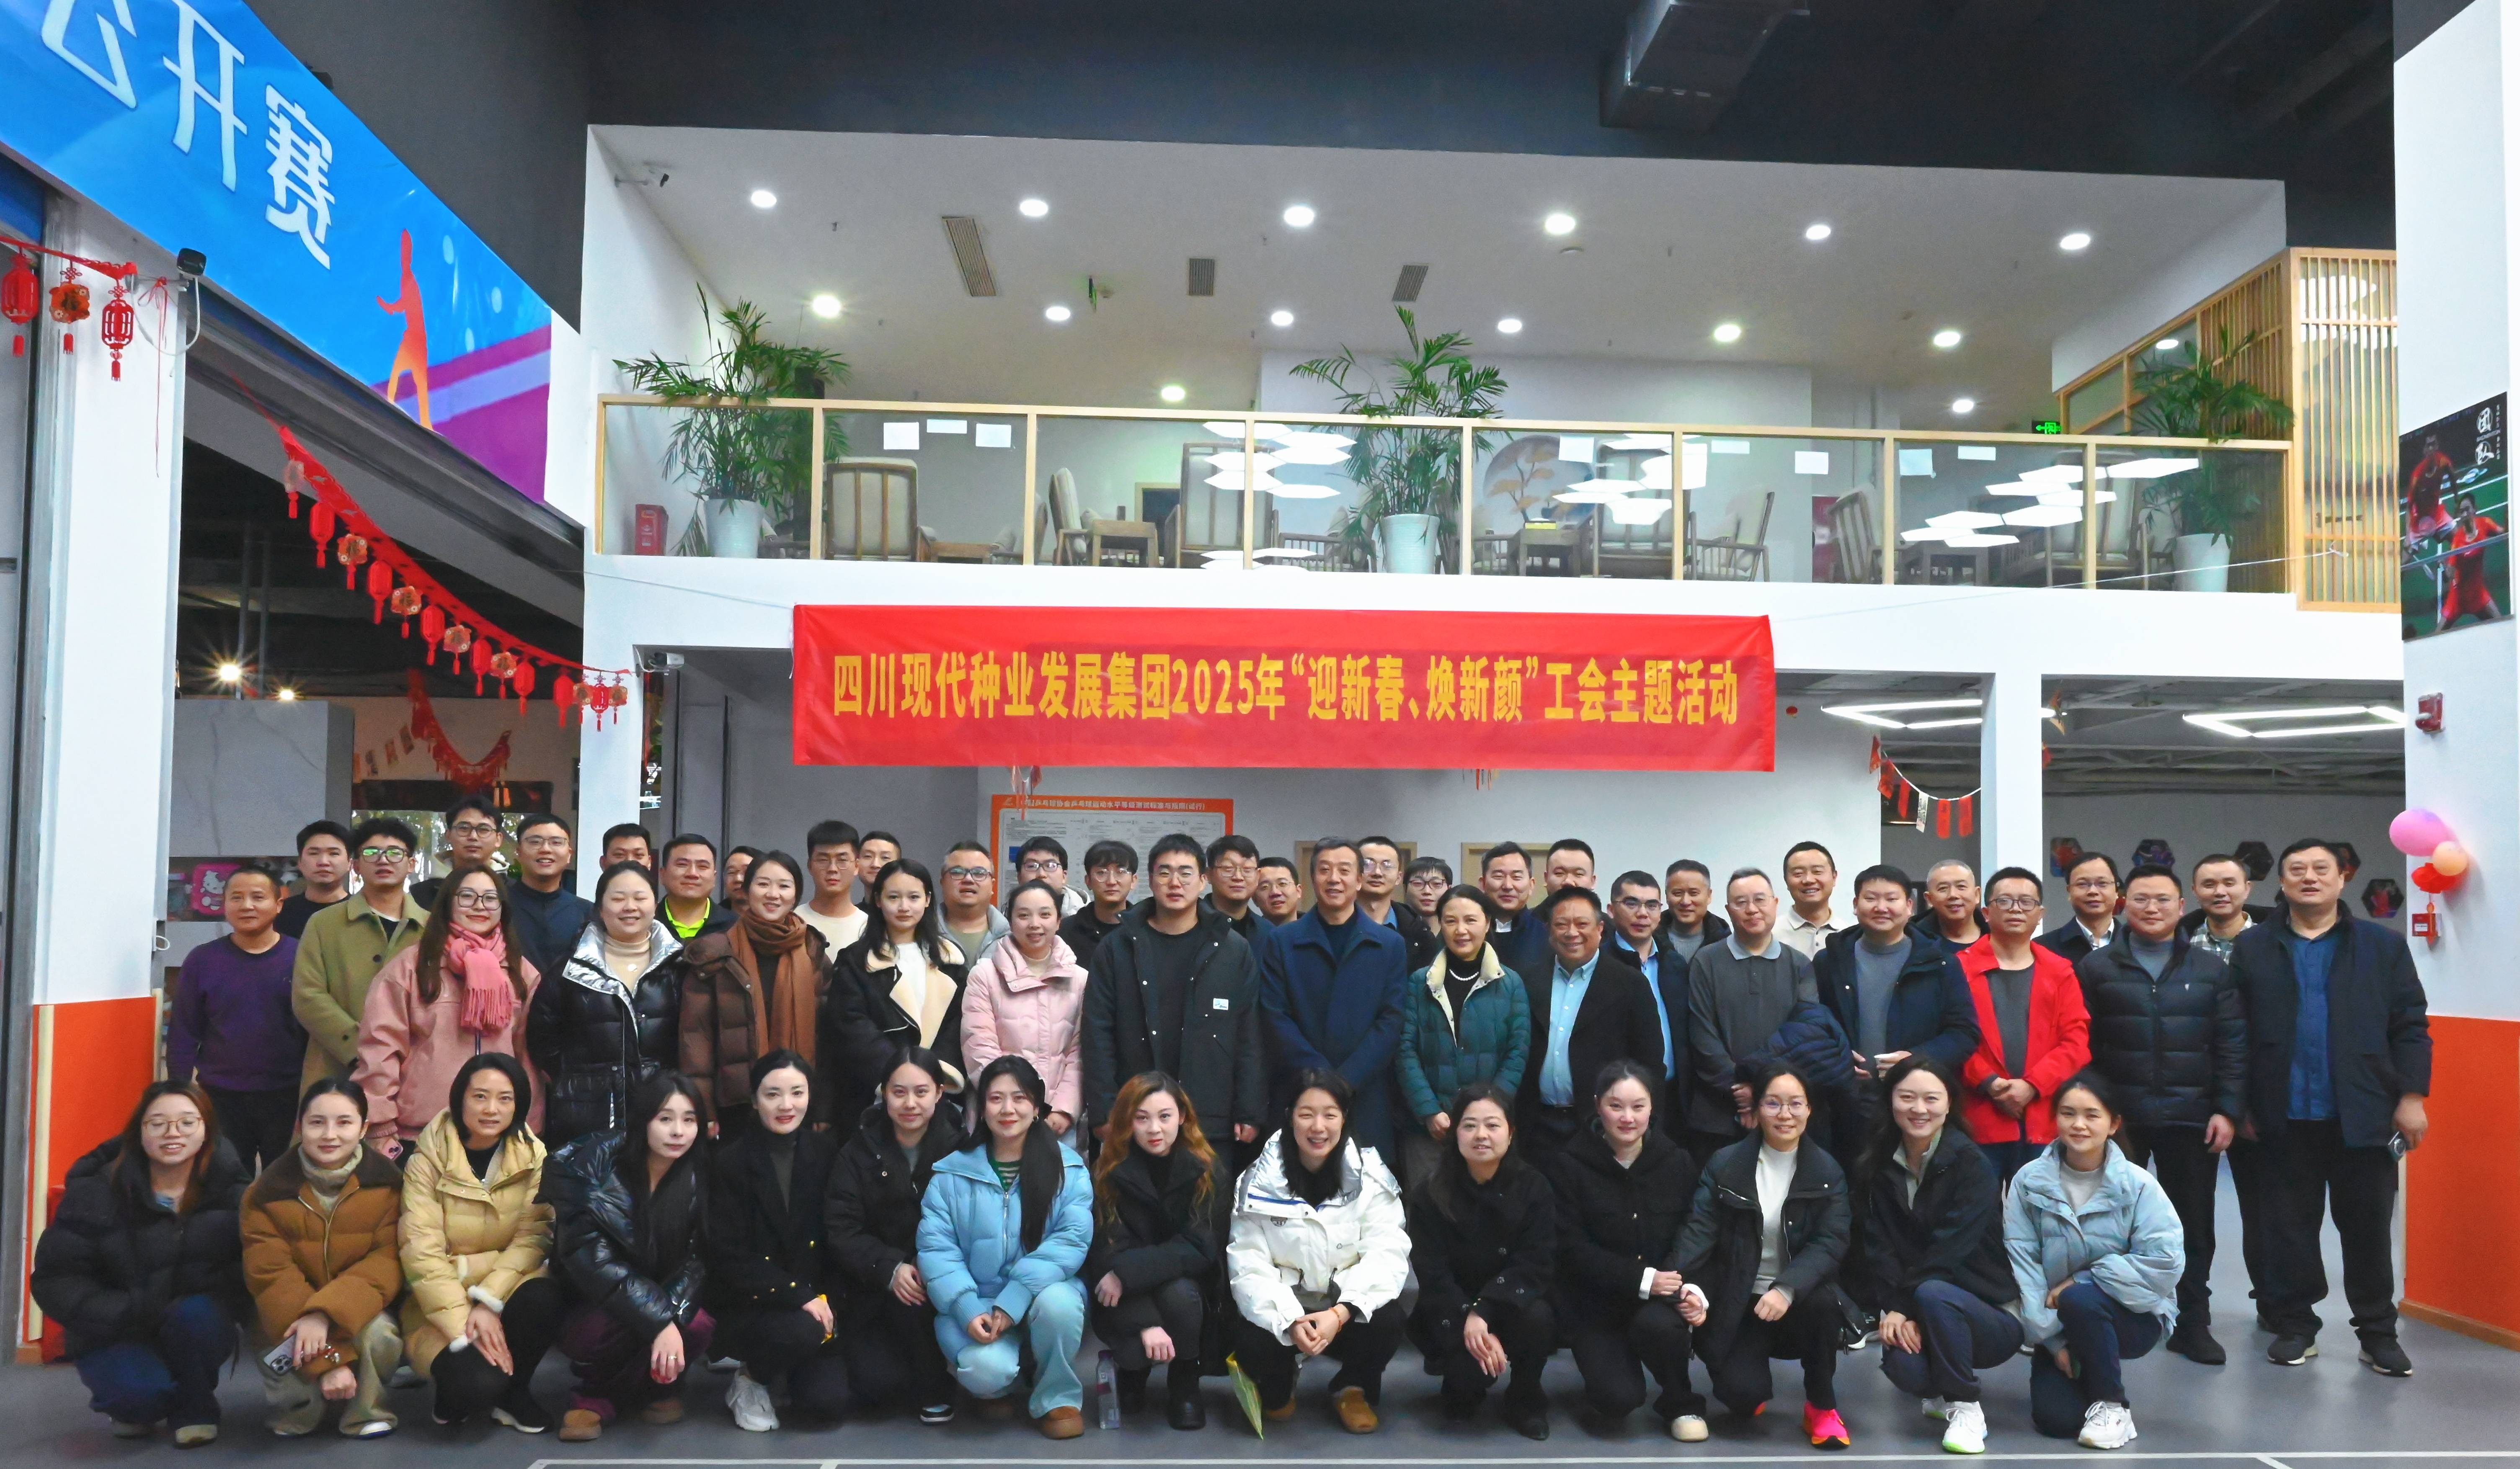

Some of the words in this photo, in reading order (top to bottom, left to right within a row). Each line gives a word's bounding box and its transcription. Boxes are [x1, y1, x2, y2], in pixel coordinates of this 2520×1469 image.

[41, 0, 335, 270] 公开赛
[834, 651, 1738, 724] 四川现代种业发展集团2025年“迎新春、焕新颜”工会主题活动
